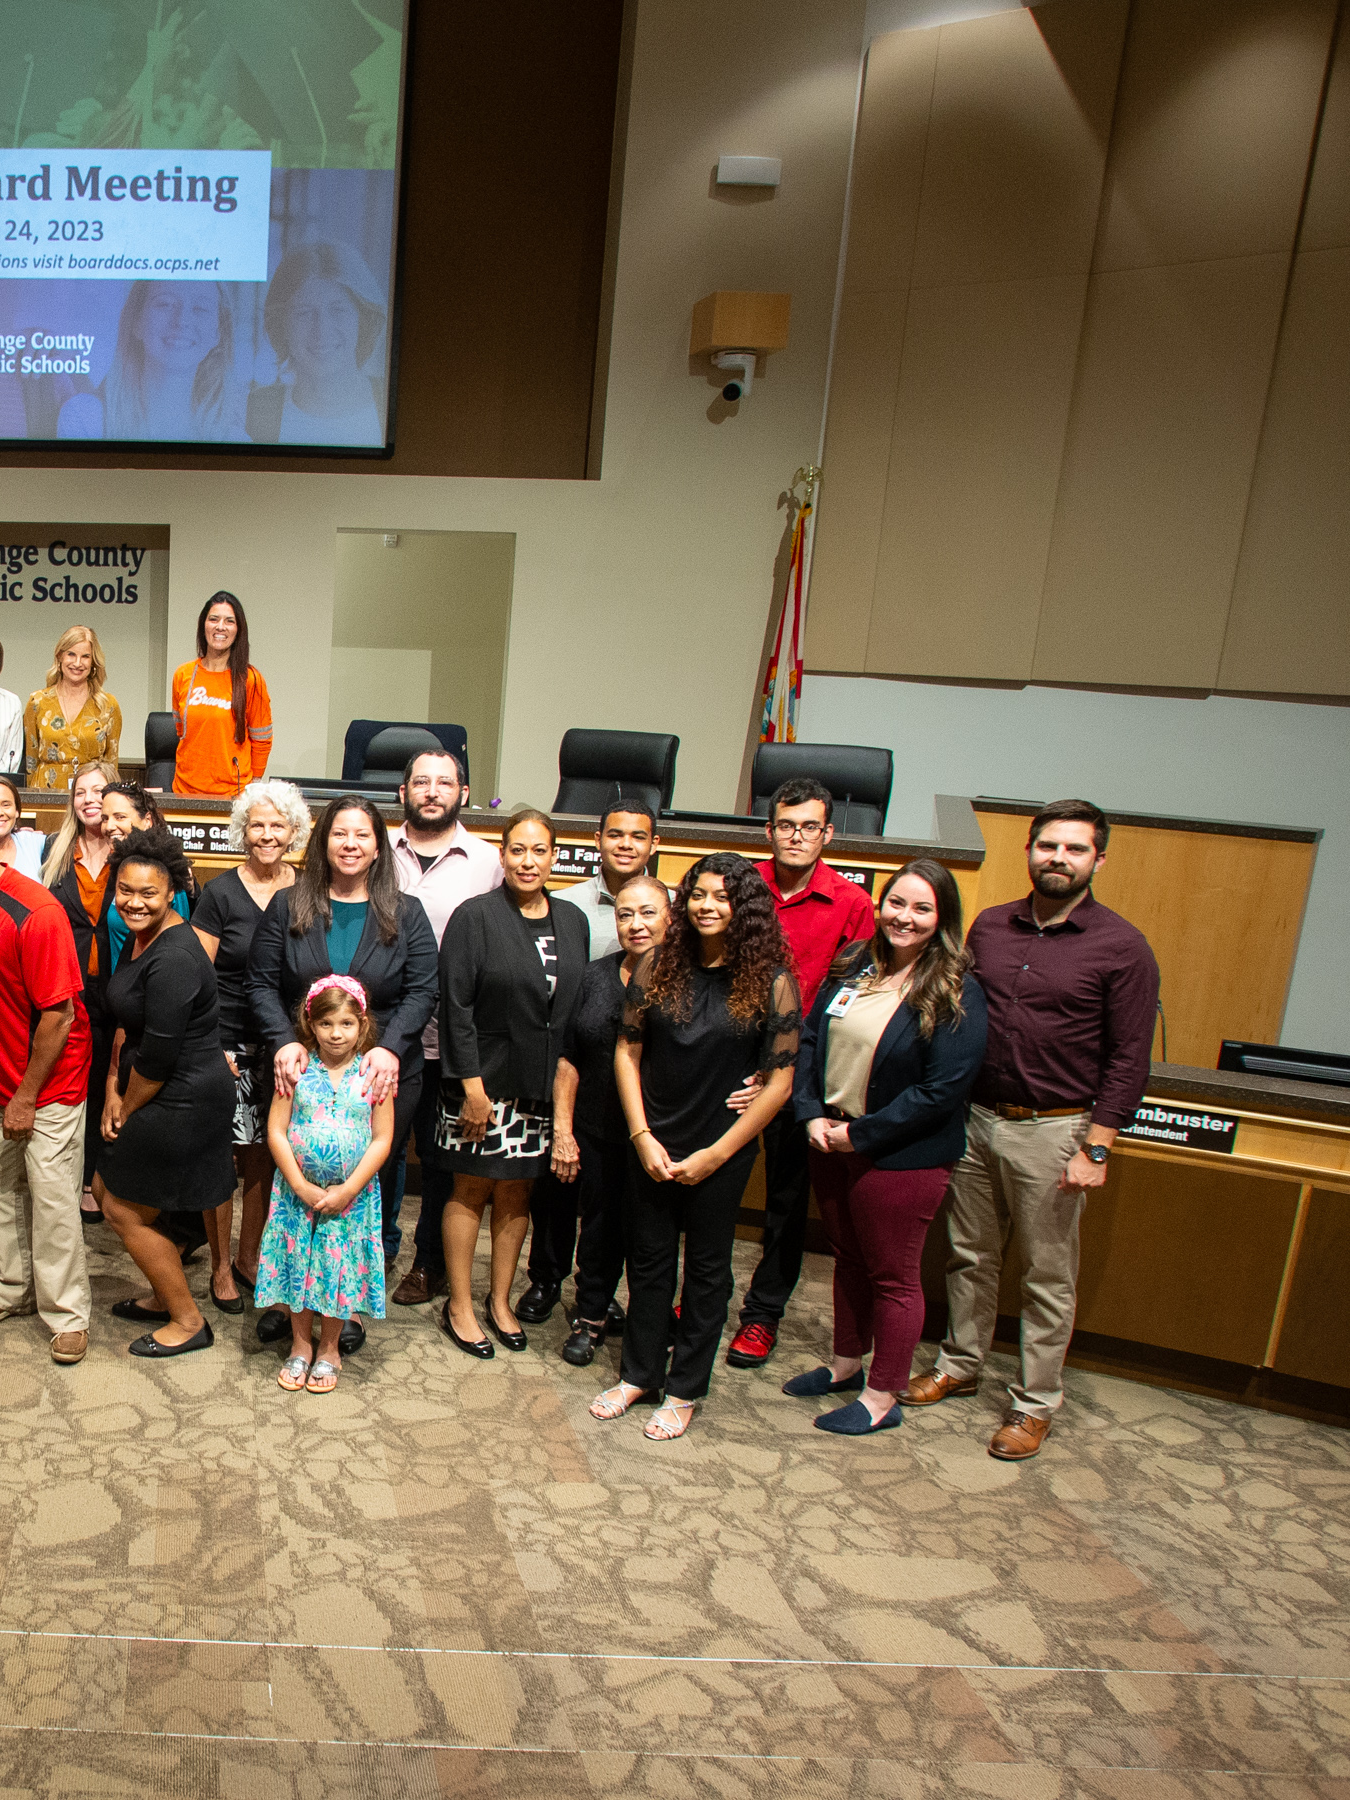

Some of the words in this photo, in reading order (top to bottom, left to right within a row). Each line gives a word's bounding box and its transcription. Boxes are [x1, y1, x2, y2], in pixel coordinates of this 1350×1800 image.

[65, 165, 239, 213] Meeting
[5, 219, 39, 245] 24,
[47, 219, 104, 241] 2023
[32, 254, 64, 269] visit
[67, 254, 221, 273] boarddocs.ocps.net
[31, 332, 95, 356] County
[20, 355, 91, 374] Schools
[48, 540, 146, 577] County
[32, 575, 139, 605] Schools
[209, 826, 230, 839] Ga
[183, 840, 204, 850] Chair
[210, 841, 238, 852] Distri
[574, 848, 603, 862] Far
[551, 862, 586, 874] Member
[1135, 1107, 1235, 1133] mbruster
[1120, 1123, 1190, 1142] rintendent
